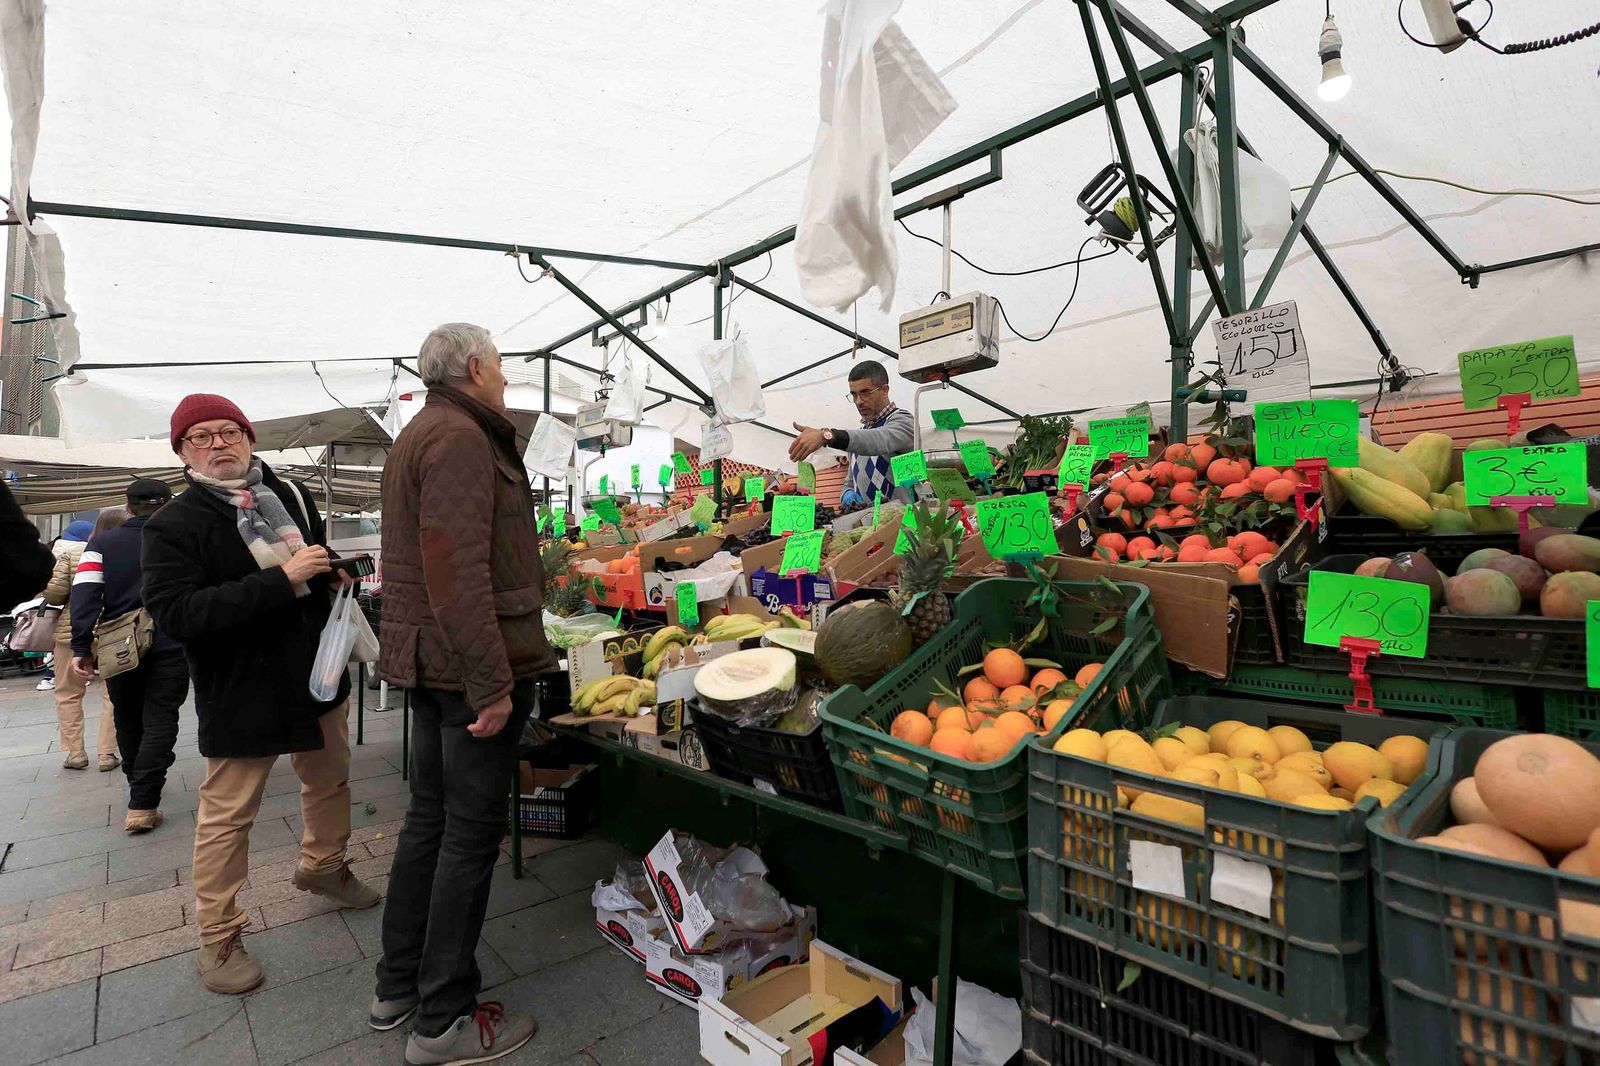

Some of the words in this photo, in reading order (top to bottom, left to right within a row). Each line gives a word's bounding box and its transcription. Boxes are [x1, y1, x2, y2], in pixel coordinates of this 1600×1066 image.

[1215, 308, 1289, 332] TESORILLO
[1462, 343, 1536, 368] PAPAYA
[1262, 402, 1317, 421] SIN
[1268, 421, 1351, 443] HUESO
[1522, 446, 1567, 455] EXTRA
[982, 501, 1028, 512] FRESCA
[661, 874, 681, 917] CAROL
[610, 922, 631, 941] CAROL
[667, 969, 697, 993] CAROL
